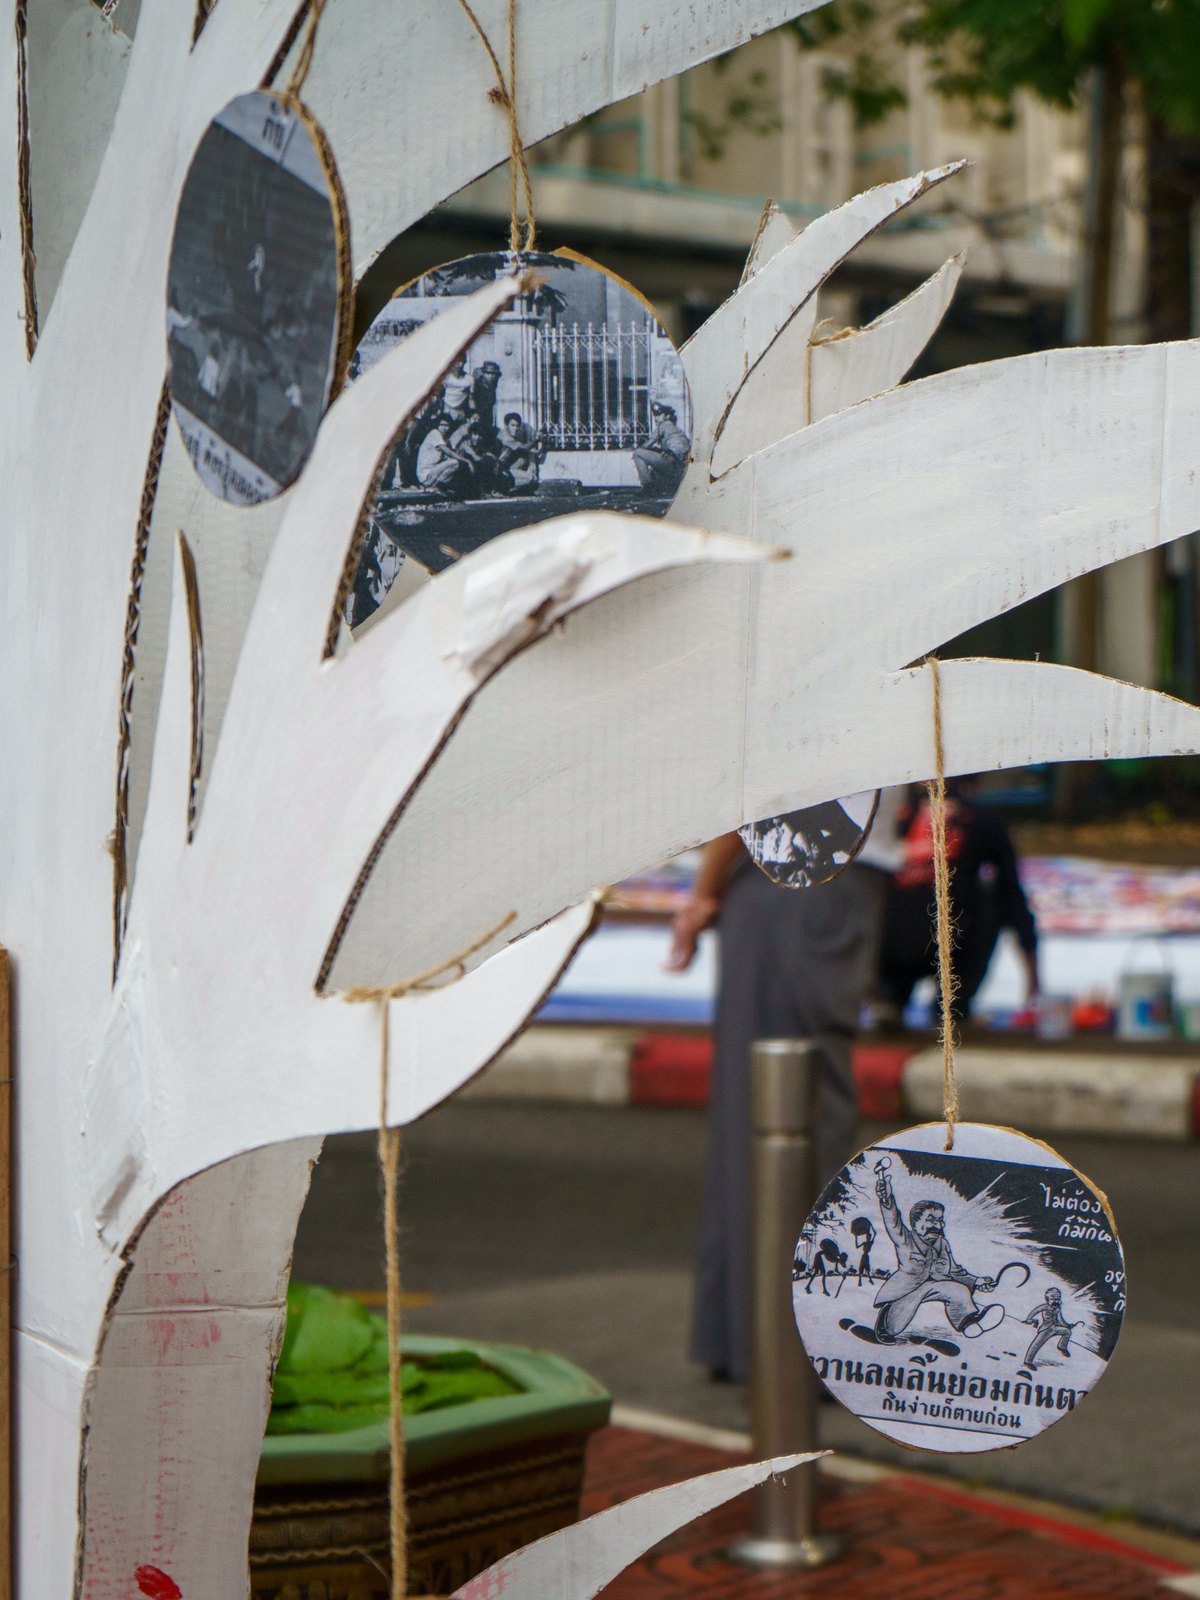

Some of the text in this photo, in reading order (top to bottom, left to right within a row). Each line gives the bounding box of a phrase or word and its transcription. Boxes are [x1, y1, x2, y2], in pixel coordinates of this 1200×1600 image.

[808, 1352, 1088, 1412] วานลมลิ้นย่อมกินต
